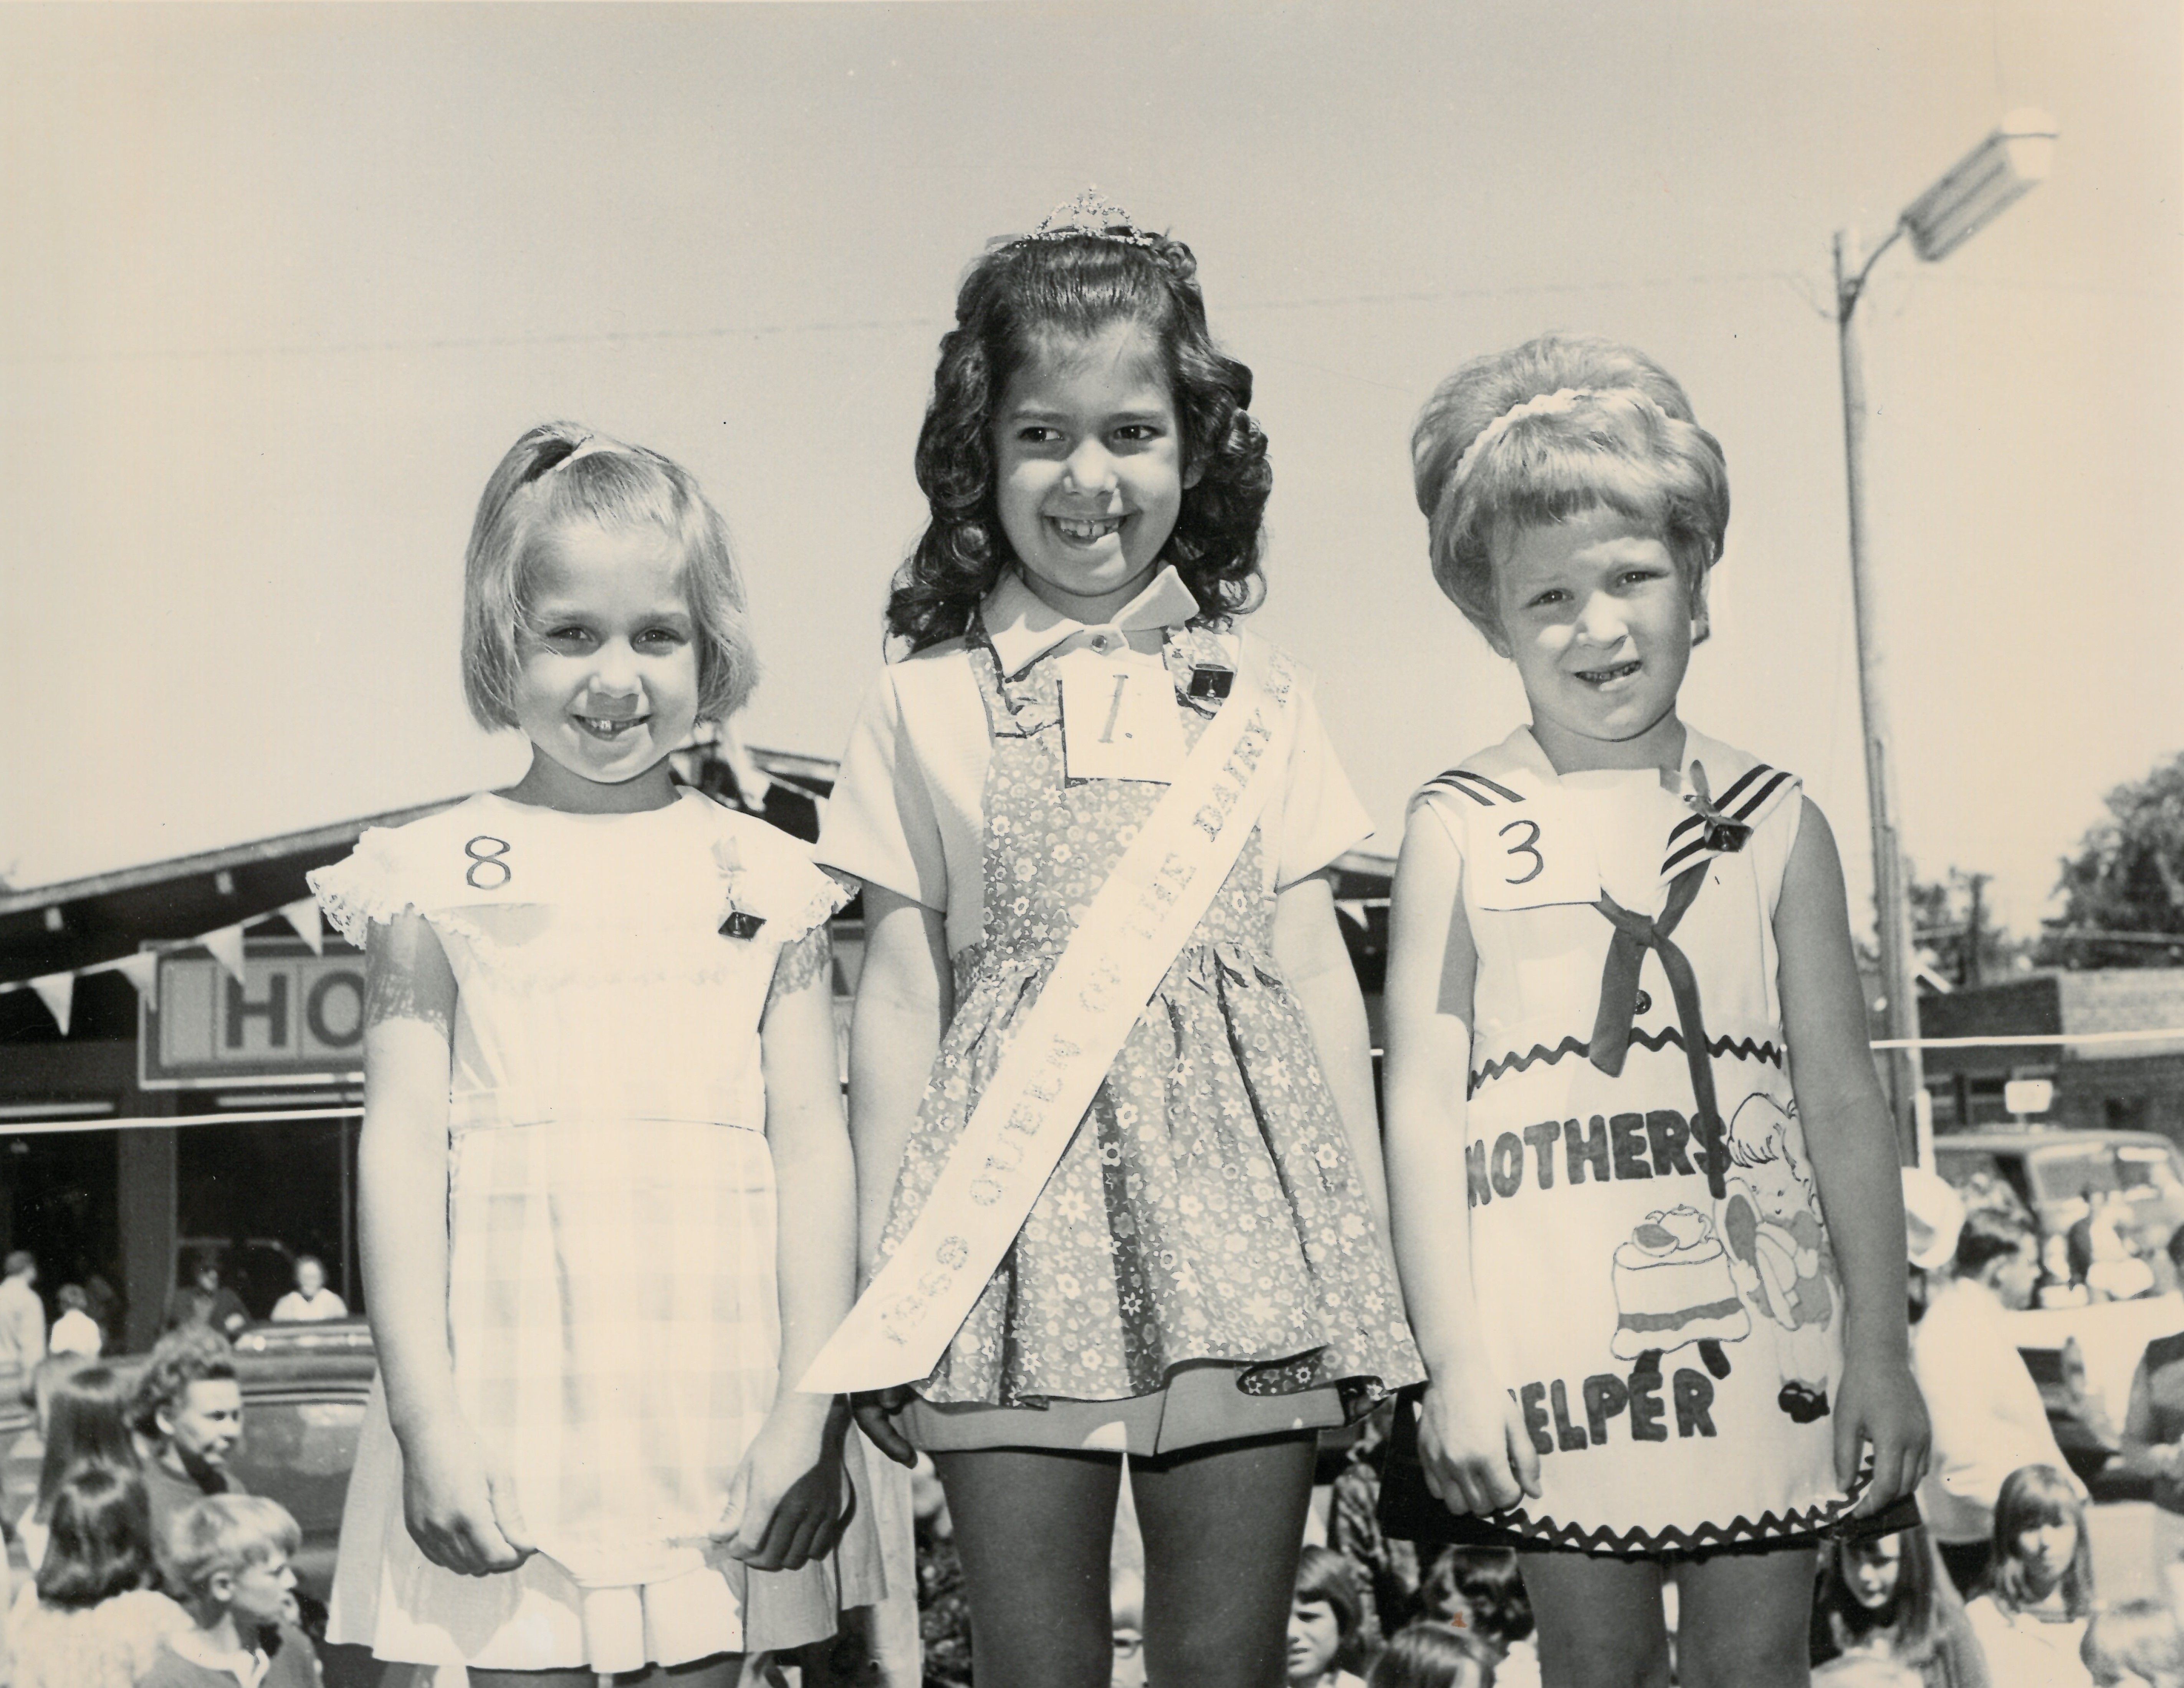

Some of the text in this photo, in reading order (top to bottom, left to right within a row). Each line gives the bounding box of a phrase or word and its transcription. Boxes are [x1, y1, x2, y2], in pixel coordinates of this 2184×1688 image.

[465, 836, 511, 890] 8
[1499, 820, 1544, 884] 3
[969, 1034, 1082, 1206] QUEEN
[1079, 953, 1120, 1013] OF
[1119, 852, 1197, 940] THE
[1192, 707, 1272, 843] DAIRY
[1507, 1368, 1717, 1455] ELPER
